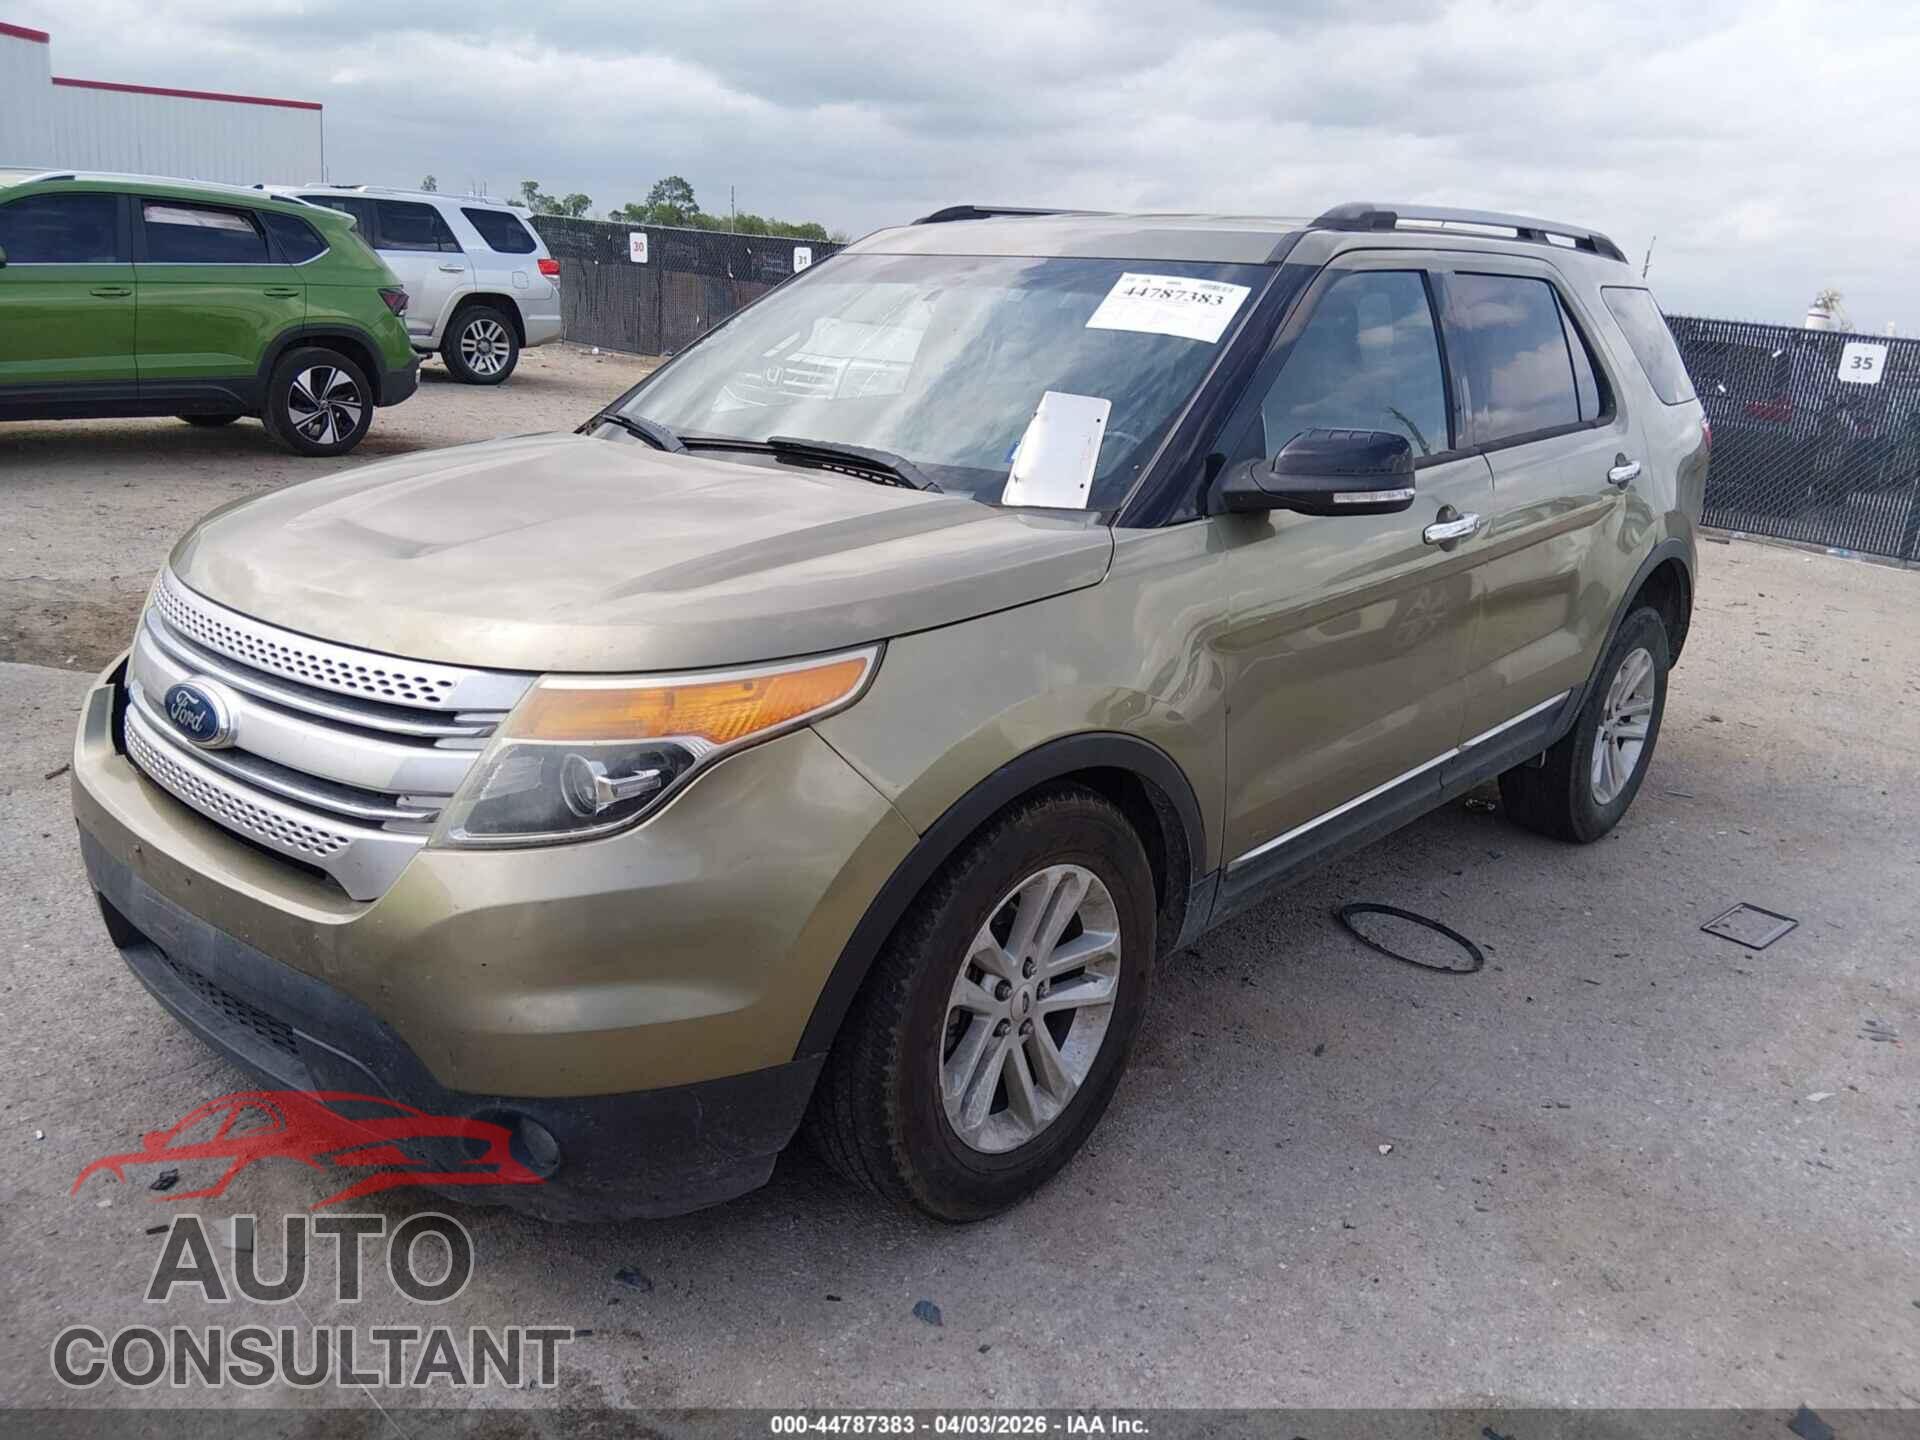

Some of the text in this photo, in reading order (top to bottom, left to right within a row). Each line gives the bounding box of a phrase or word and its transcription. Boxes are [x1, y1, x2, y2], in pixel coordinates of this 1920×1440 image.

[633, 240, 644, 252] 30
[1122, 285, 1224, 305] 44787383
[1850, 355, 1874, 370] 35
[170, 689, 207, 732] Ford
